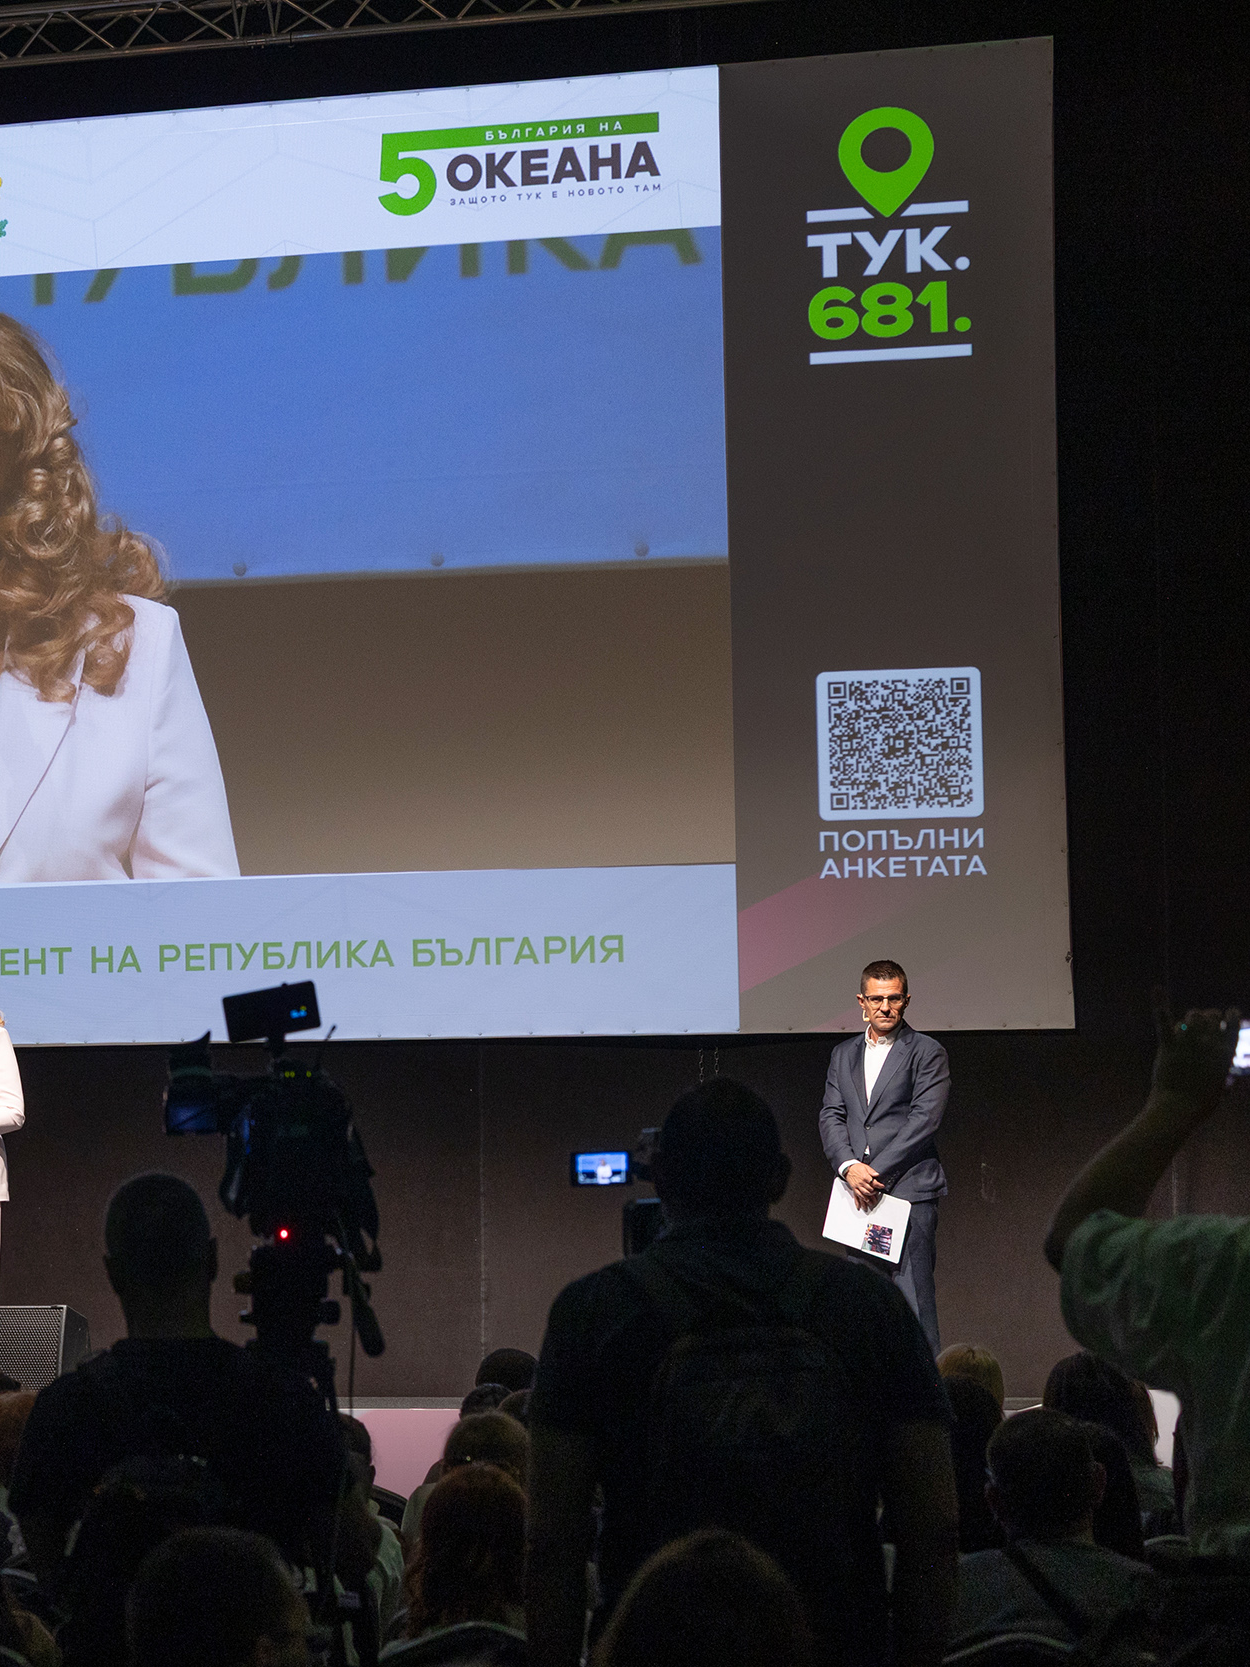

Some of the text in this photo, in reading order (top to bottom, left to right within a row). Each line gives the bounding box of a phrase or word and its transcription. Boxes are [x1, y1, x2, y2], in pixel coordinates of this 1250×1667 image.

[485, 120, 623, 141] БЪЛГАРИЯ НА
[446, 140, 661, 191] ОКЕАНА
[450, 183, 662, 206] ЗАЩОТО ТУК Е НОВОТО ТАМ
[806, 225, 971, 278] ТУК.
[808, 280, 972, 341] 681.
[819, 828, 985, 852] ПОПЪЛНИ
[819, 855, 988, 880] АНКЕТАТА
[91, 945, 142, 974] НА
[159, 939, 395, 972] РЕПУБЛИКА
[412, 934, 625, 968] БЪЛГАРИЯ
